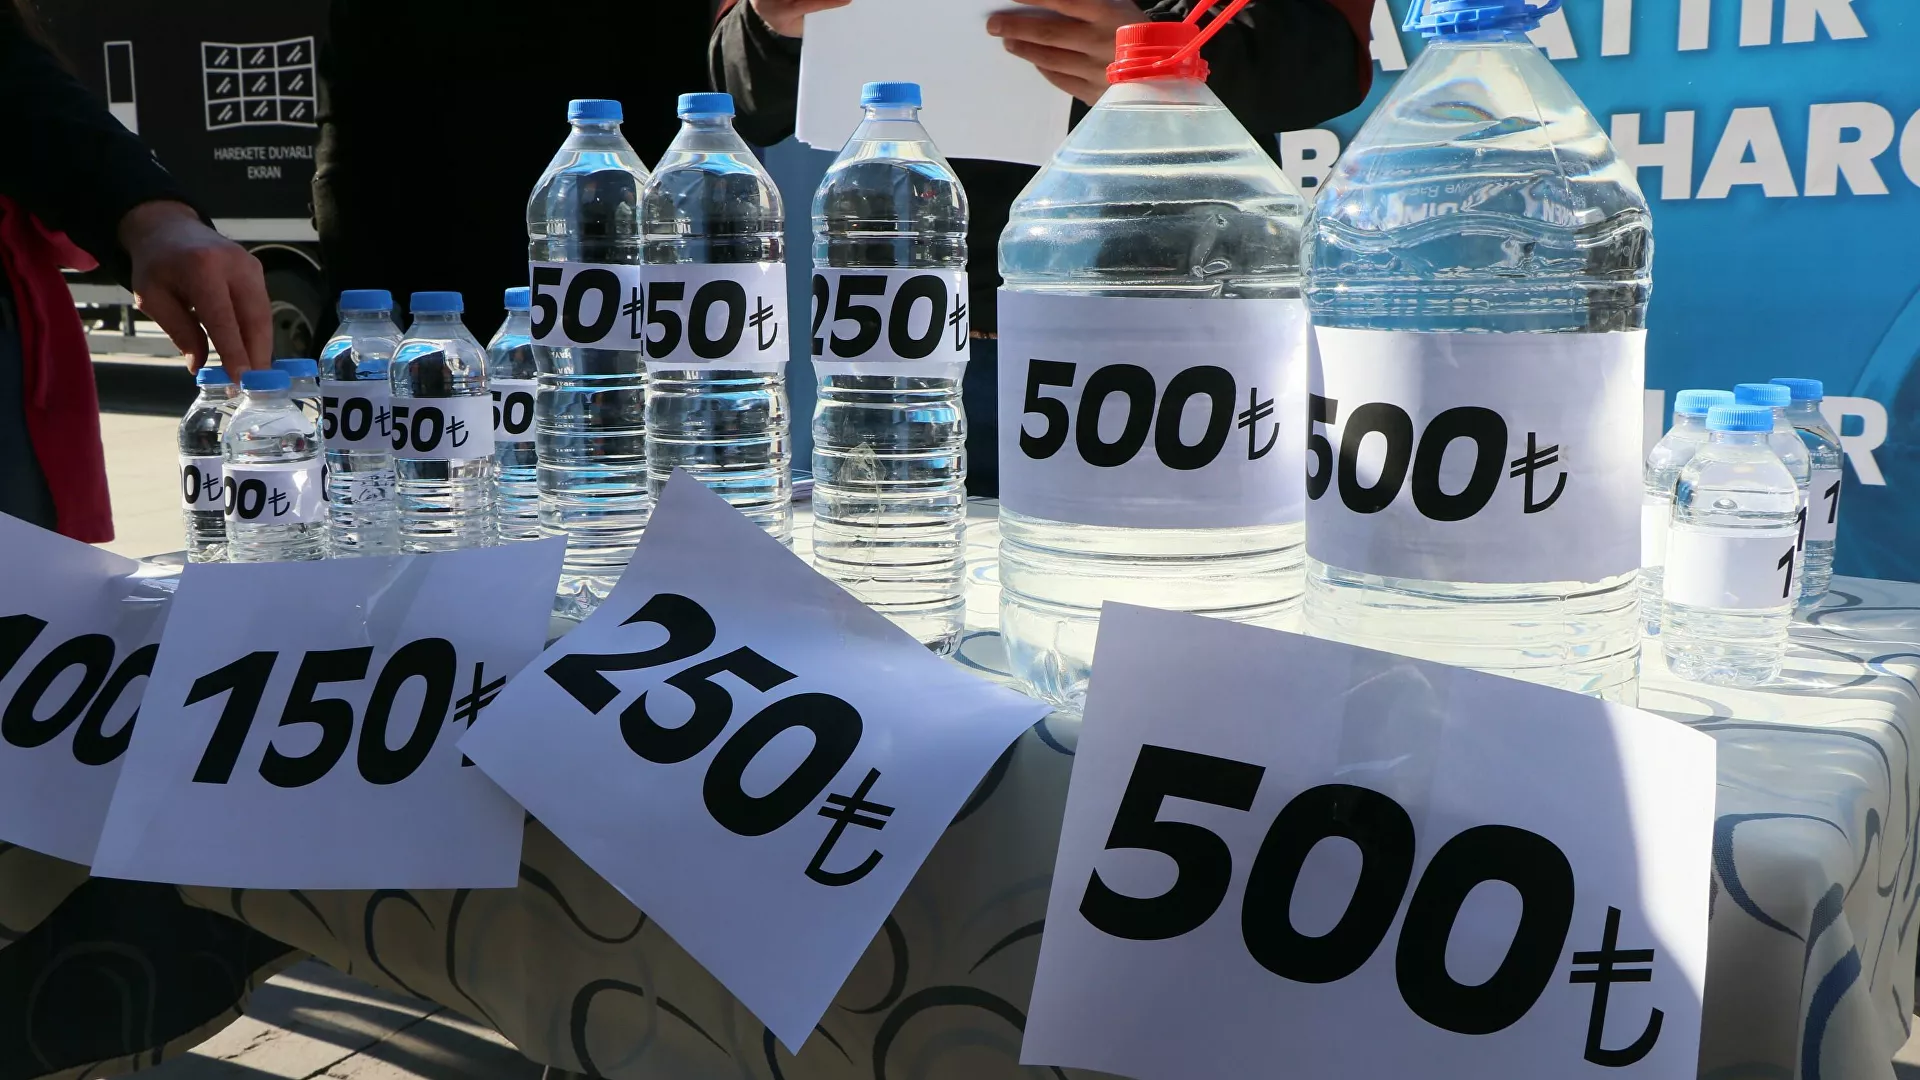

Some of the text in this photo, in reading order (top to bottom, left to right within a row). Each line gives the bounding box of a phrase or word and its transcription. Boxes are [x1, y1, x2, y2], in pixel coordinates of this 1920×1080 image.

[213, 145, 314, 161] HAREKETE DUYARLI
[246, 165, 282, 180] EKRAN
[1610, 101, 1920, 200] HAR
[1019, 358, 1280, 471] 500₺
[544, 592, 896, 887] 250₺
[1078, 743, 1665, 1068] 500₺
